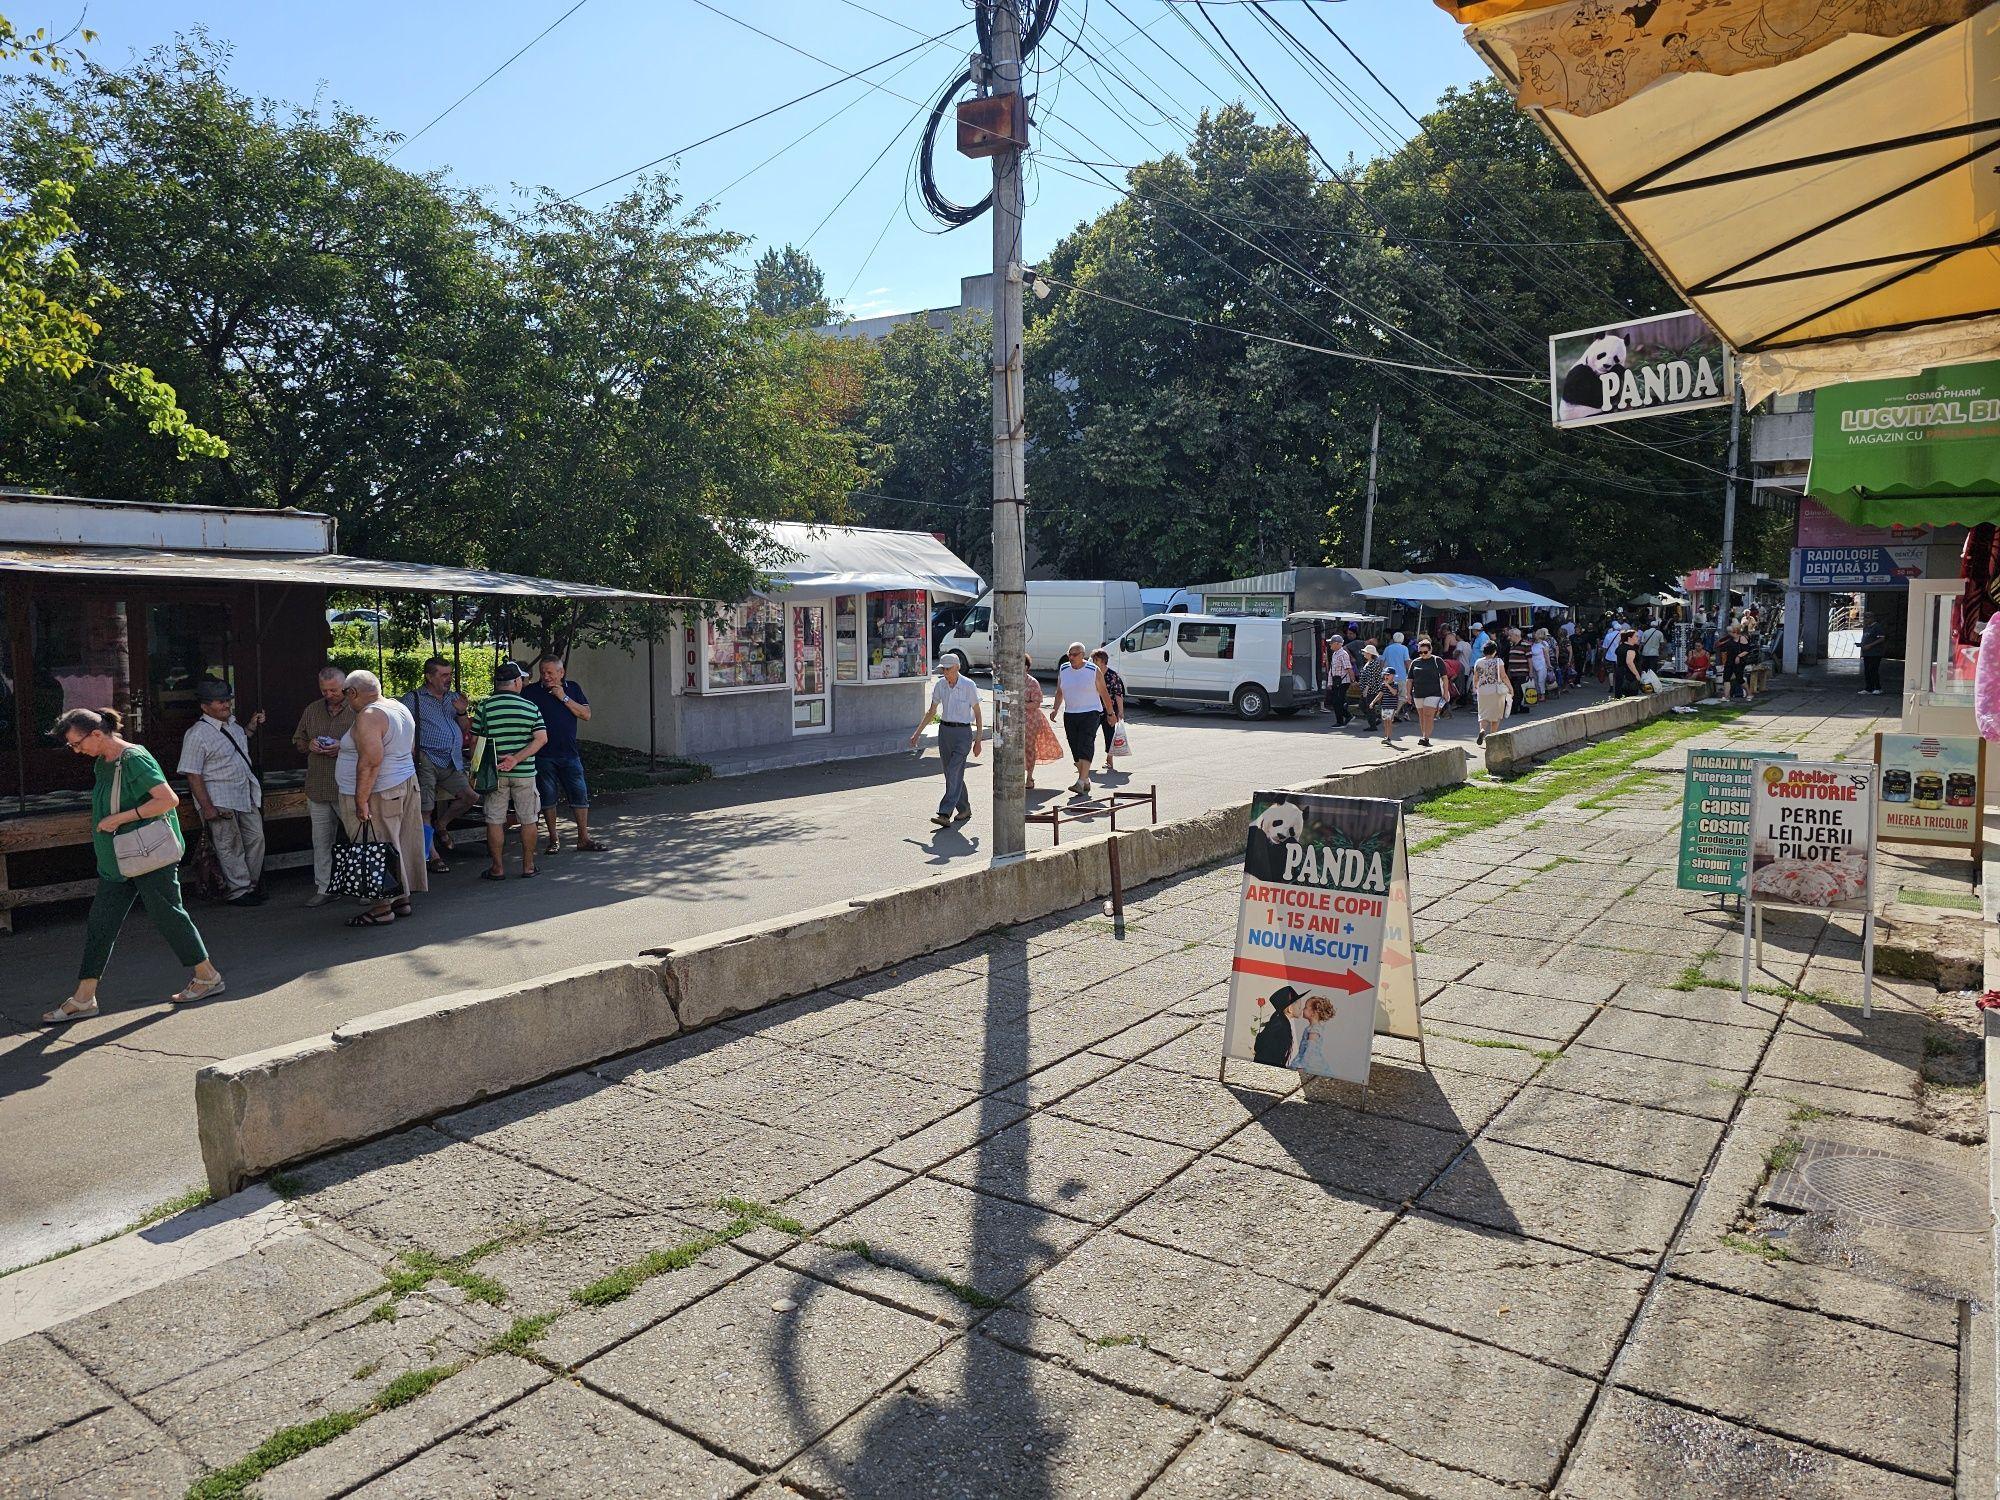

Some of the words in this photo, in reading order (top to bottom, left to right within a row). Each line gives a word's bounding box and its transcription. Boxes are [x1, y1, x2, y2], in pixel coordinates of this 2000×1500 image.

[1600, 356, 1718, 411] PANDA
[1906, 391, 1941, 401] COSMO
[1944, 388, 1981, 398] PHARM
[1841, 402, 1967, 431] LUCVITAL
[1969, 399, 2000, 422] BI
[1848, 432, 1903, 445] MAGAZIN
[1906, 431, 1923, 441] CU
[1807, 549, 1879, 561] RADIOLOGIE
[1806, 560, 1860, 574] DENTARĂ
[1863, 562, 1879, 573] 3D
[1692, 756, 1738, 770] MAGAZIN
[1740, 758, 1752, 771] NA
[1692, 771, 1733, 783] Puterea
[1734, 774, 1752, 785] nat
[1788, 770, 1838, 785] Atelier
[1708, 785, 1720, 796] în
[1720, 786, 1751, 798] mâini
[1767, 782, 1858, 802] CROITORIE
[1701, 799, 1750, 816] capsu
[1780, 807, 1843, 826] PERNE
[1887, 813, 1921, 827] MIEREA
[1923, 816, 1969, 830] TRICOLOR
[1699, 818, 1750, 836] cosme
[1768, 824, 1852, 845] LENJERII
[1698, 834, 1734, 845] produse
[1779, 843, 1842, 862] PILOTE
[1282, 842, 1387, 892] PANDA
[1691, 857, 1731, 871] siropuri
[1696, 873, 1732, 886] ceaiuri
[1246, 884, 1331, 911] ARTICOLE
[1334, 896, 1383, 918] COPII
[1266, 908, 1274, 925] 1
[1287, 911, 1305, 929] 15
[1307, 914, 1340, 935] ANI
[1248, 928, 1287, 949] NOU
[1289, 933, 1369, 966] NĂSCUȚI
